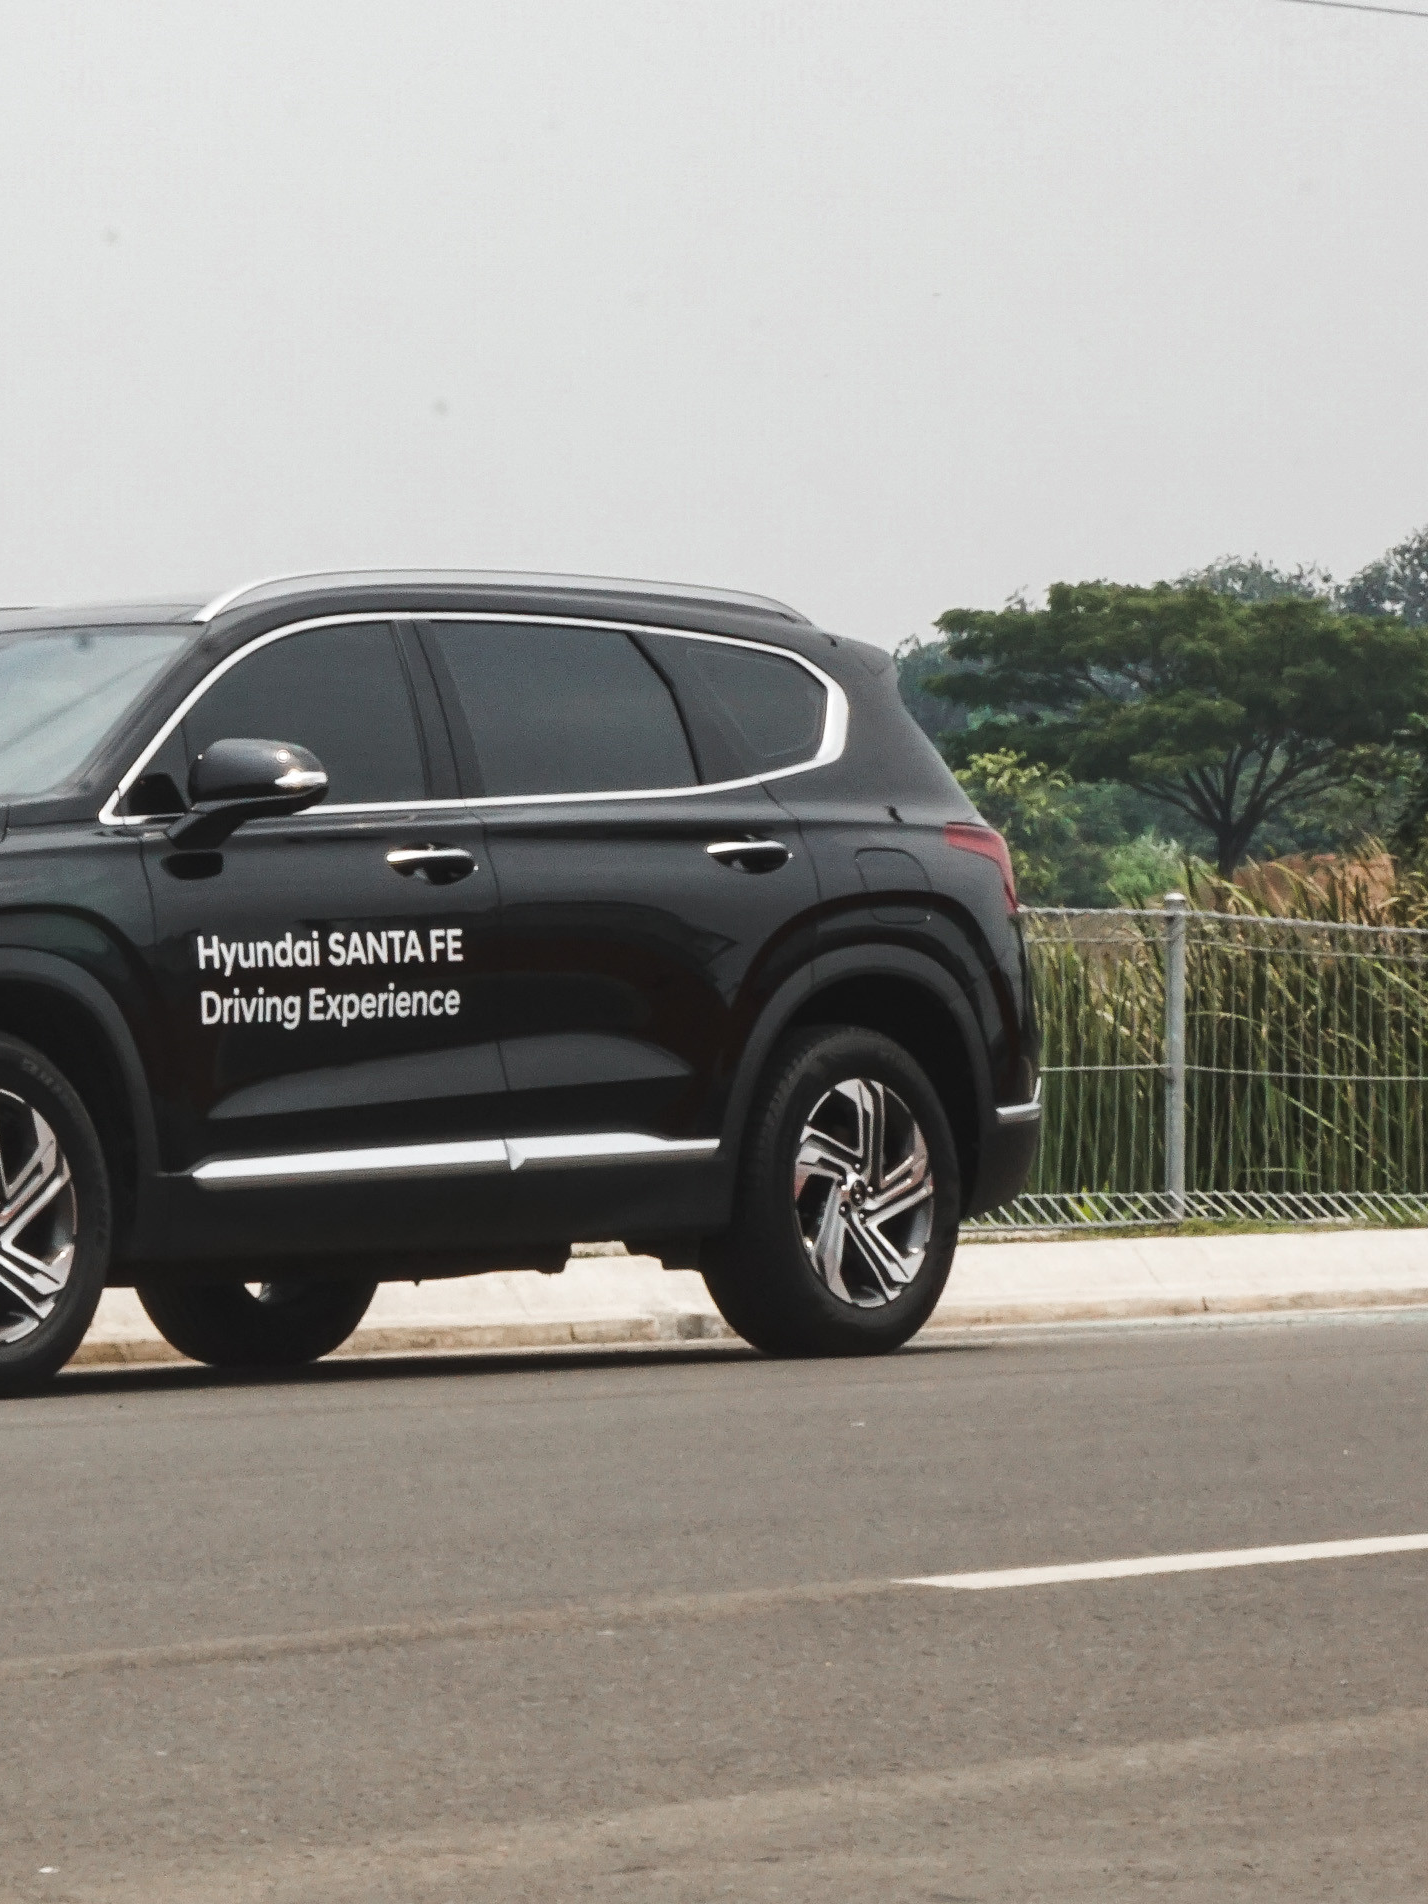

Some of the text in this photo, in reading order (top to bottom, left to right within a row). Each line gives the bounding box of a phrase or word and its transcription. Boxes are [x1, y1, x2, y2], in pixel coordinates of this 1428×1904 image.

[197, 928, 464, 977] Hyundai SANTA FE
[200, 983, 461, 1030] Driving Experience
